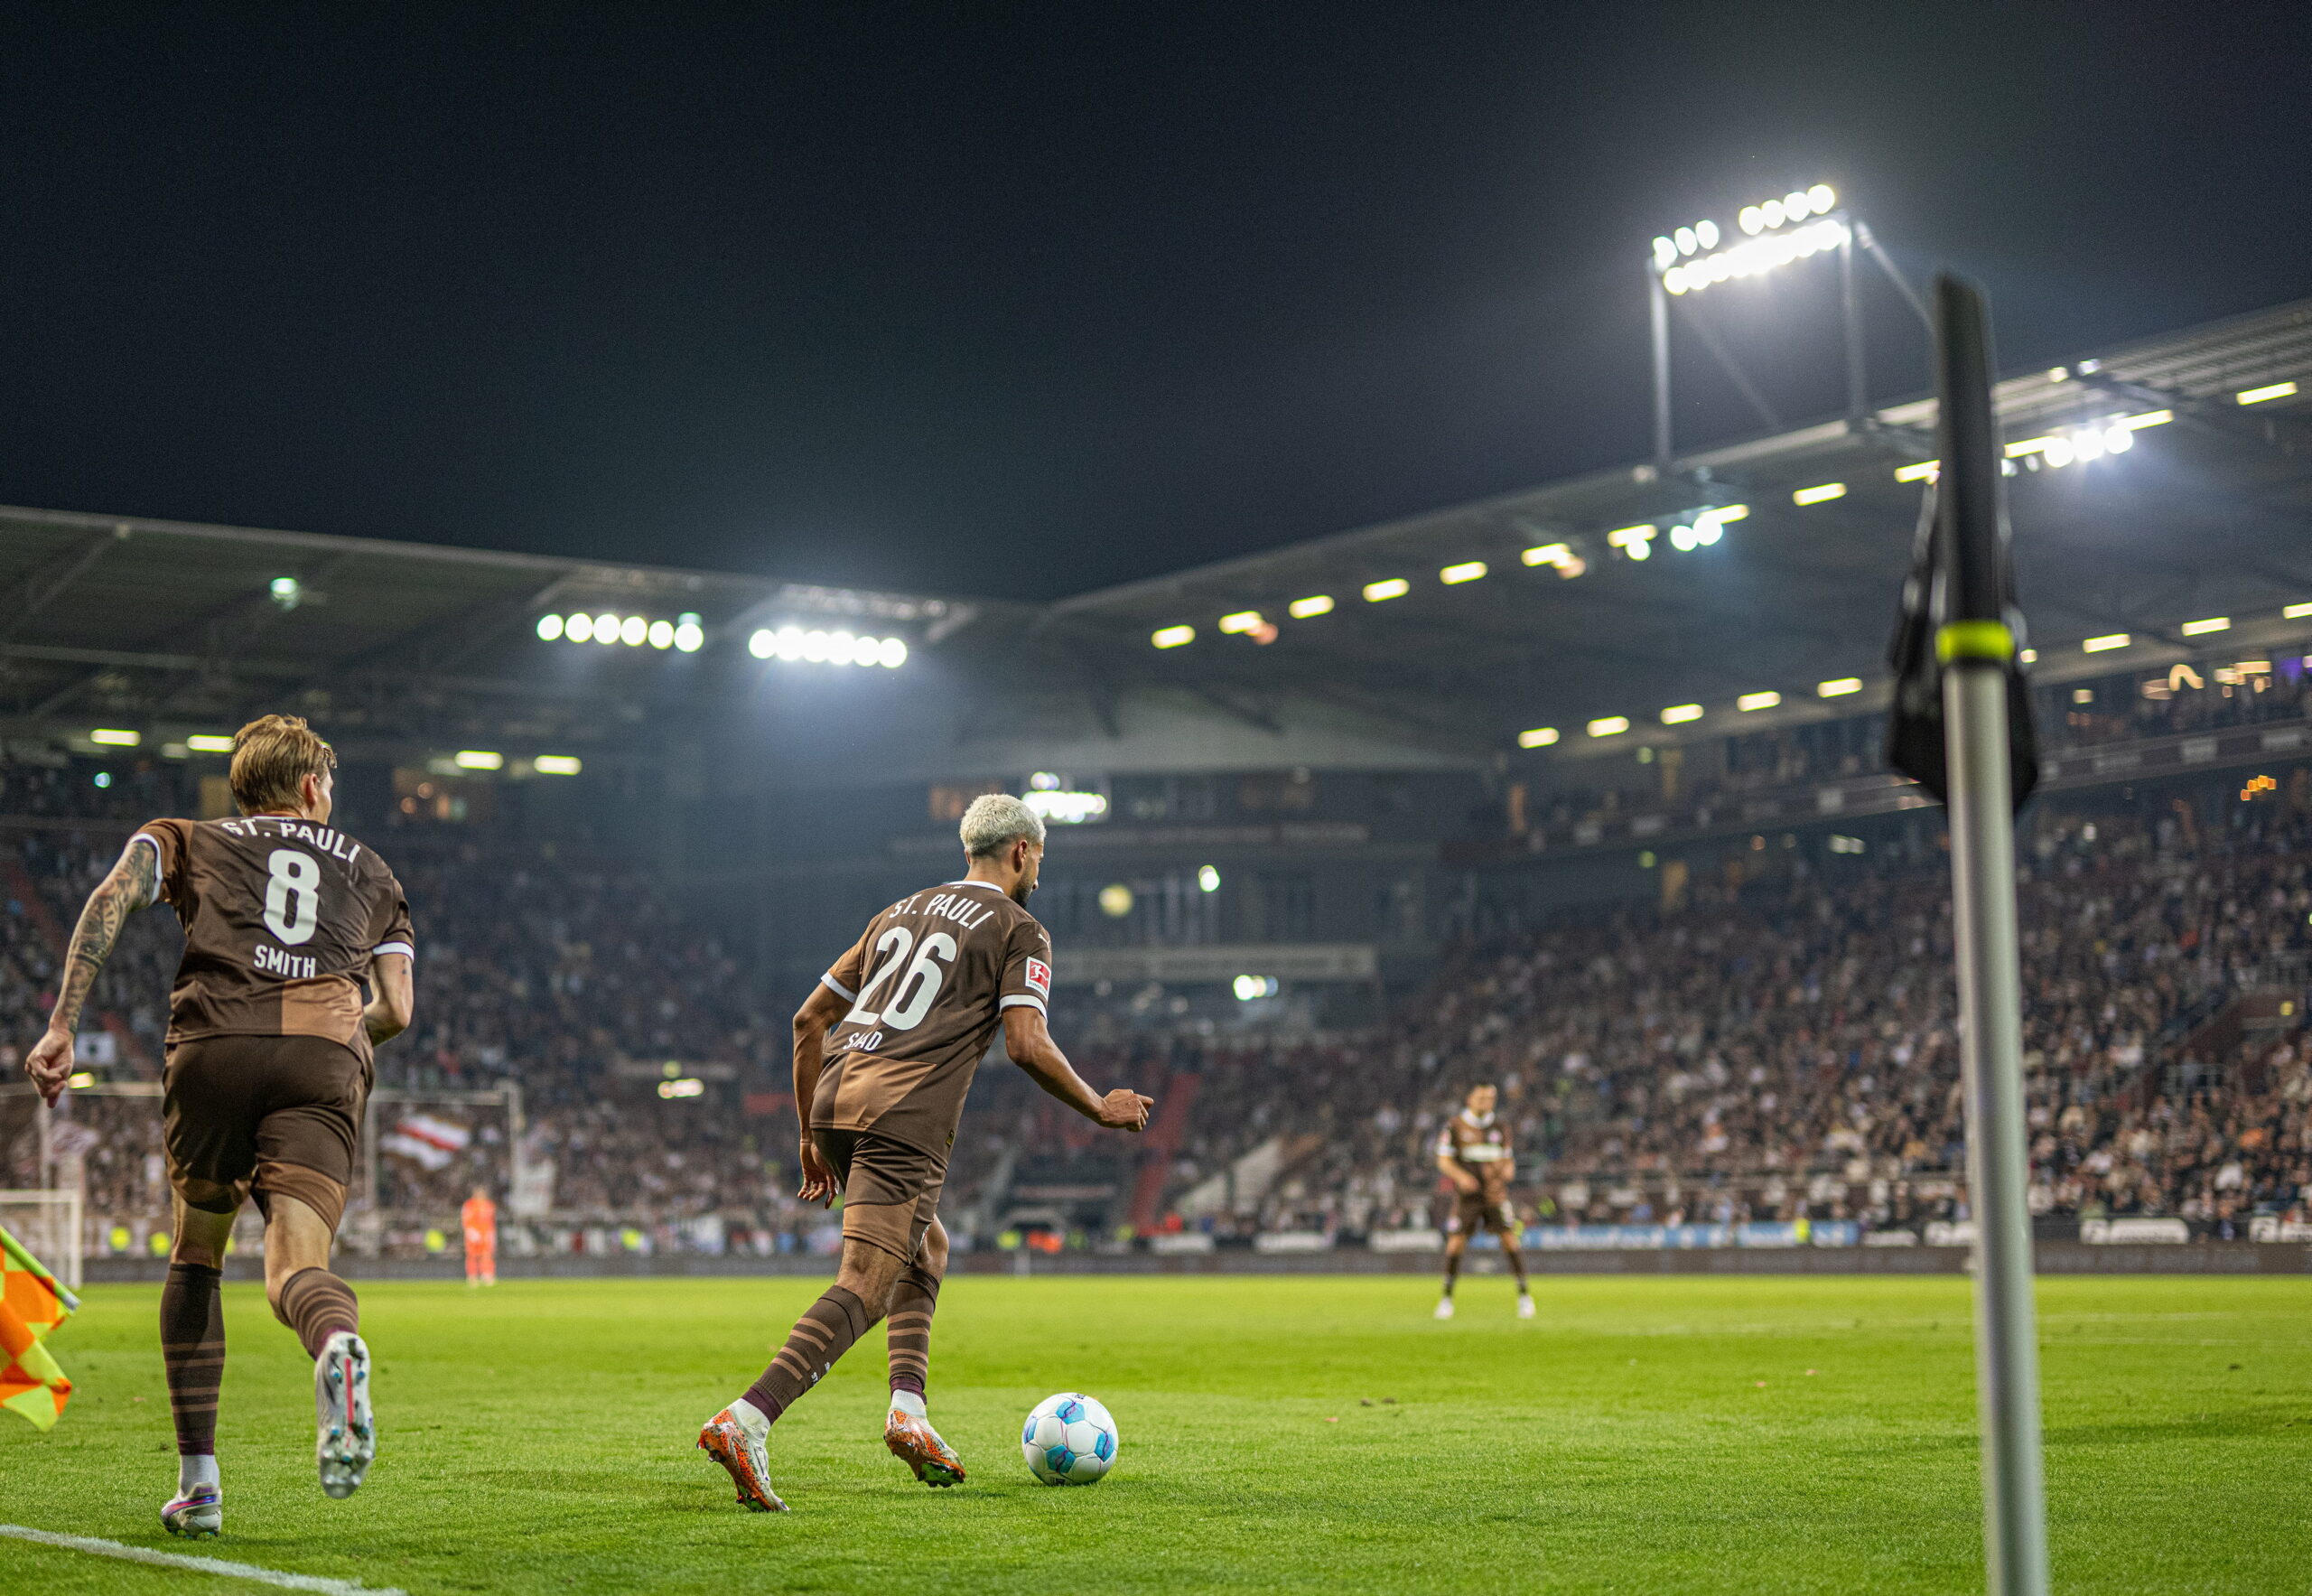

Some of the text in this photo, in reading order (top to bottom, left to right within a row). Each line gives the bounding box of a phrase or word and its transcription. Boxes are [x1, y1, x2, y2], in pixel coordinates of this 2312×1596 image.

[221, 818, 361, 864] ST. PAULI
[263, 848, 320, 946] 8
[889, 893, 994, 930] ST. PAULI
[254, 945, 316, 978] SMITH
[844, 926, 957, 1031] 26
